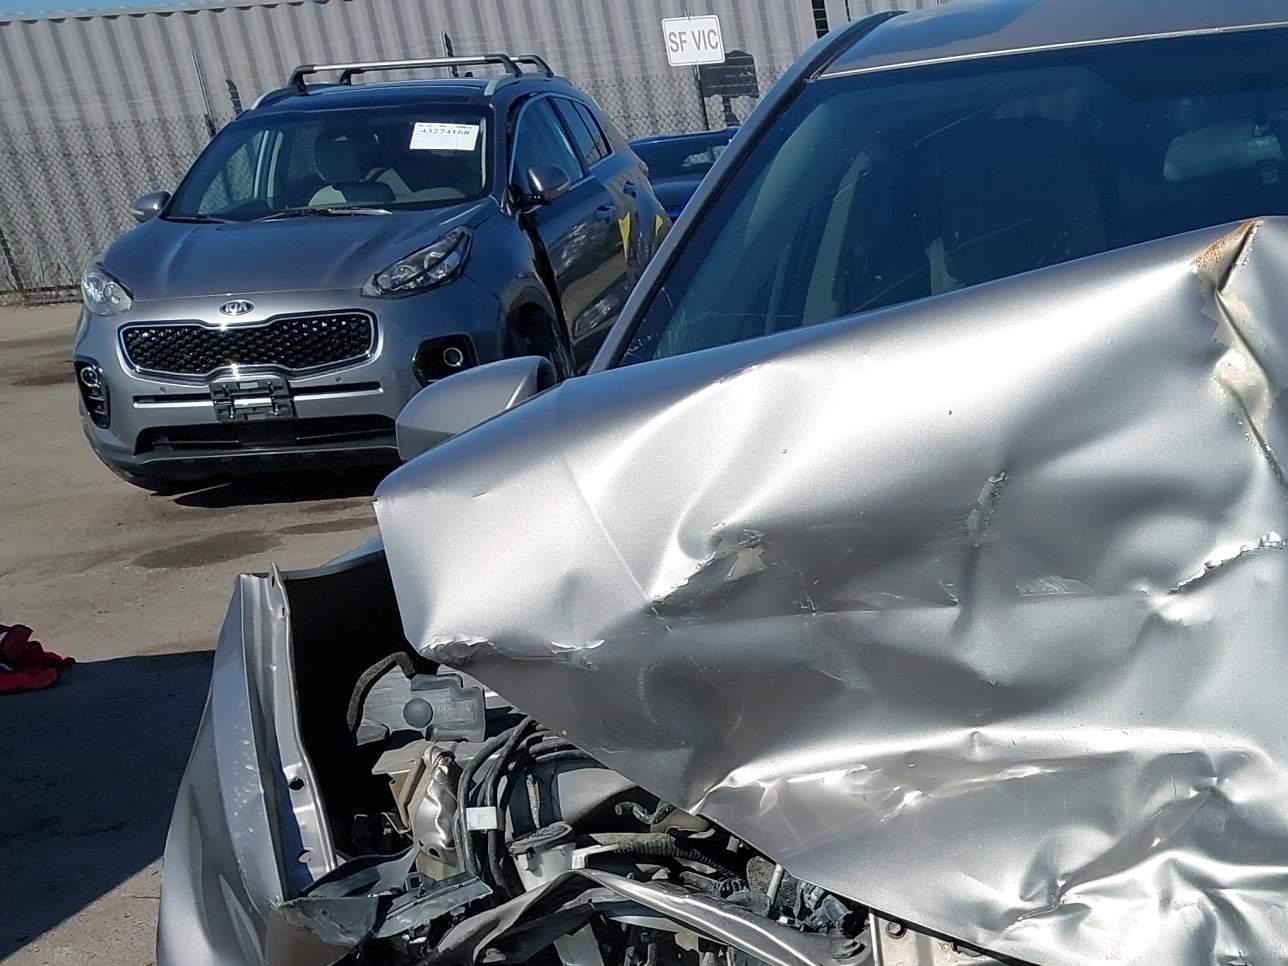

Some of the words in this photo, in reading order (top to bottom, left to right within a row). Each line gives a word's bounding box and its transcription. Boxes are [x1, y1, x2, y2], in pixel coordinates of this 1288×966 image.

[668, 31, 688, 53] SF
[691, 28, 719, 51] VIC
[224, 302, 250, 314] KIA
